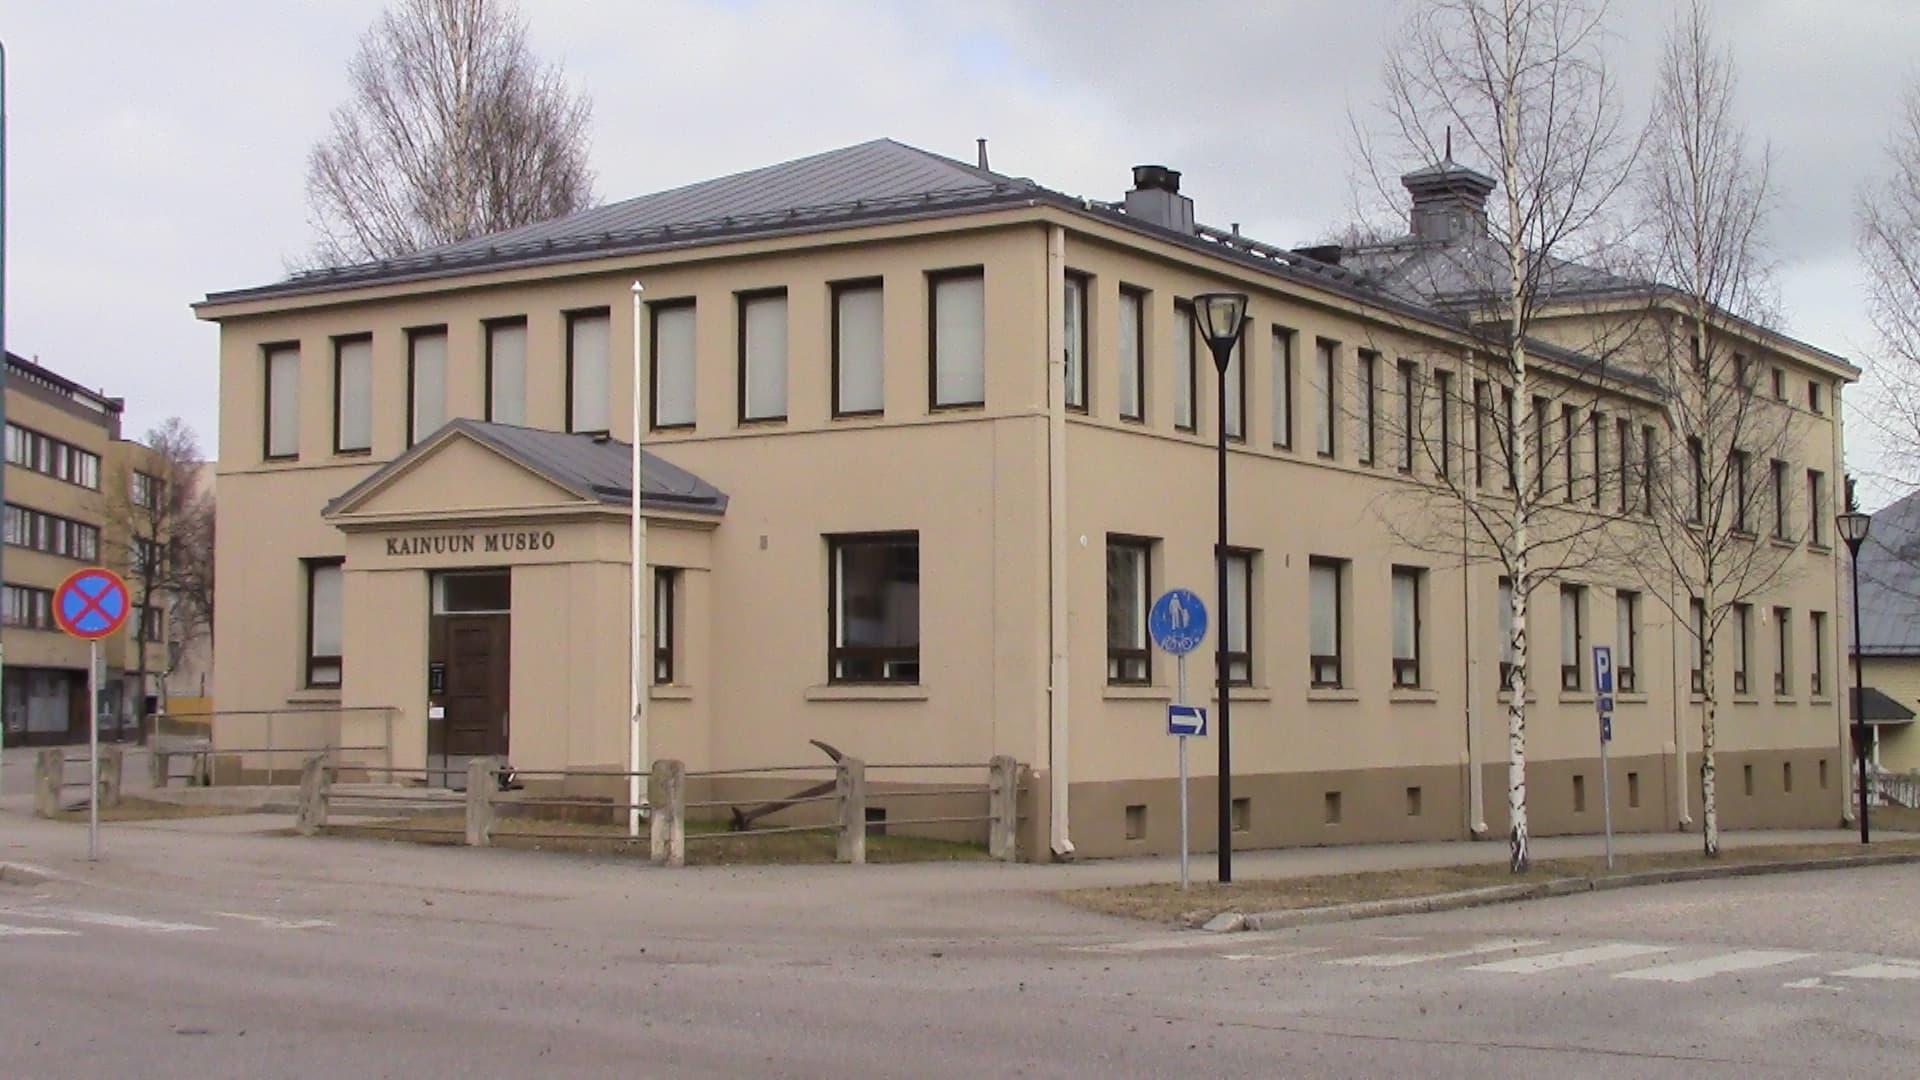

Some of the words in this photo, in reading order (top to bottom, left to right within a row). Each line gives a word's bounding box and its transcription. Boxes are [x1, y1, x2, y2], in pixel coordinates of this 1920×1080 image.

[387, 535, 475, 556] KAINUUN
[485, 532, 555, 552] MUSEO
[1597, 648, 1610, 689] P
